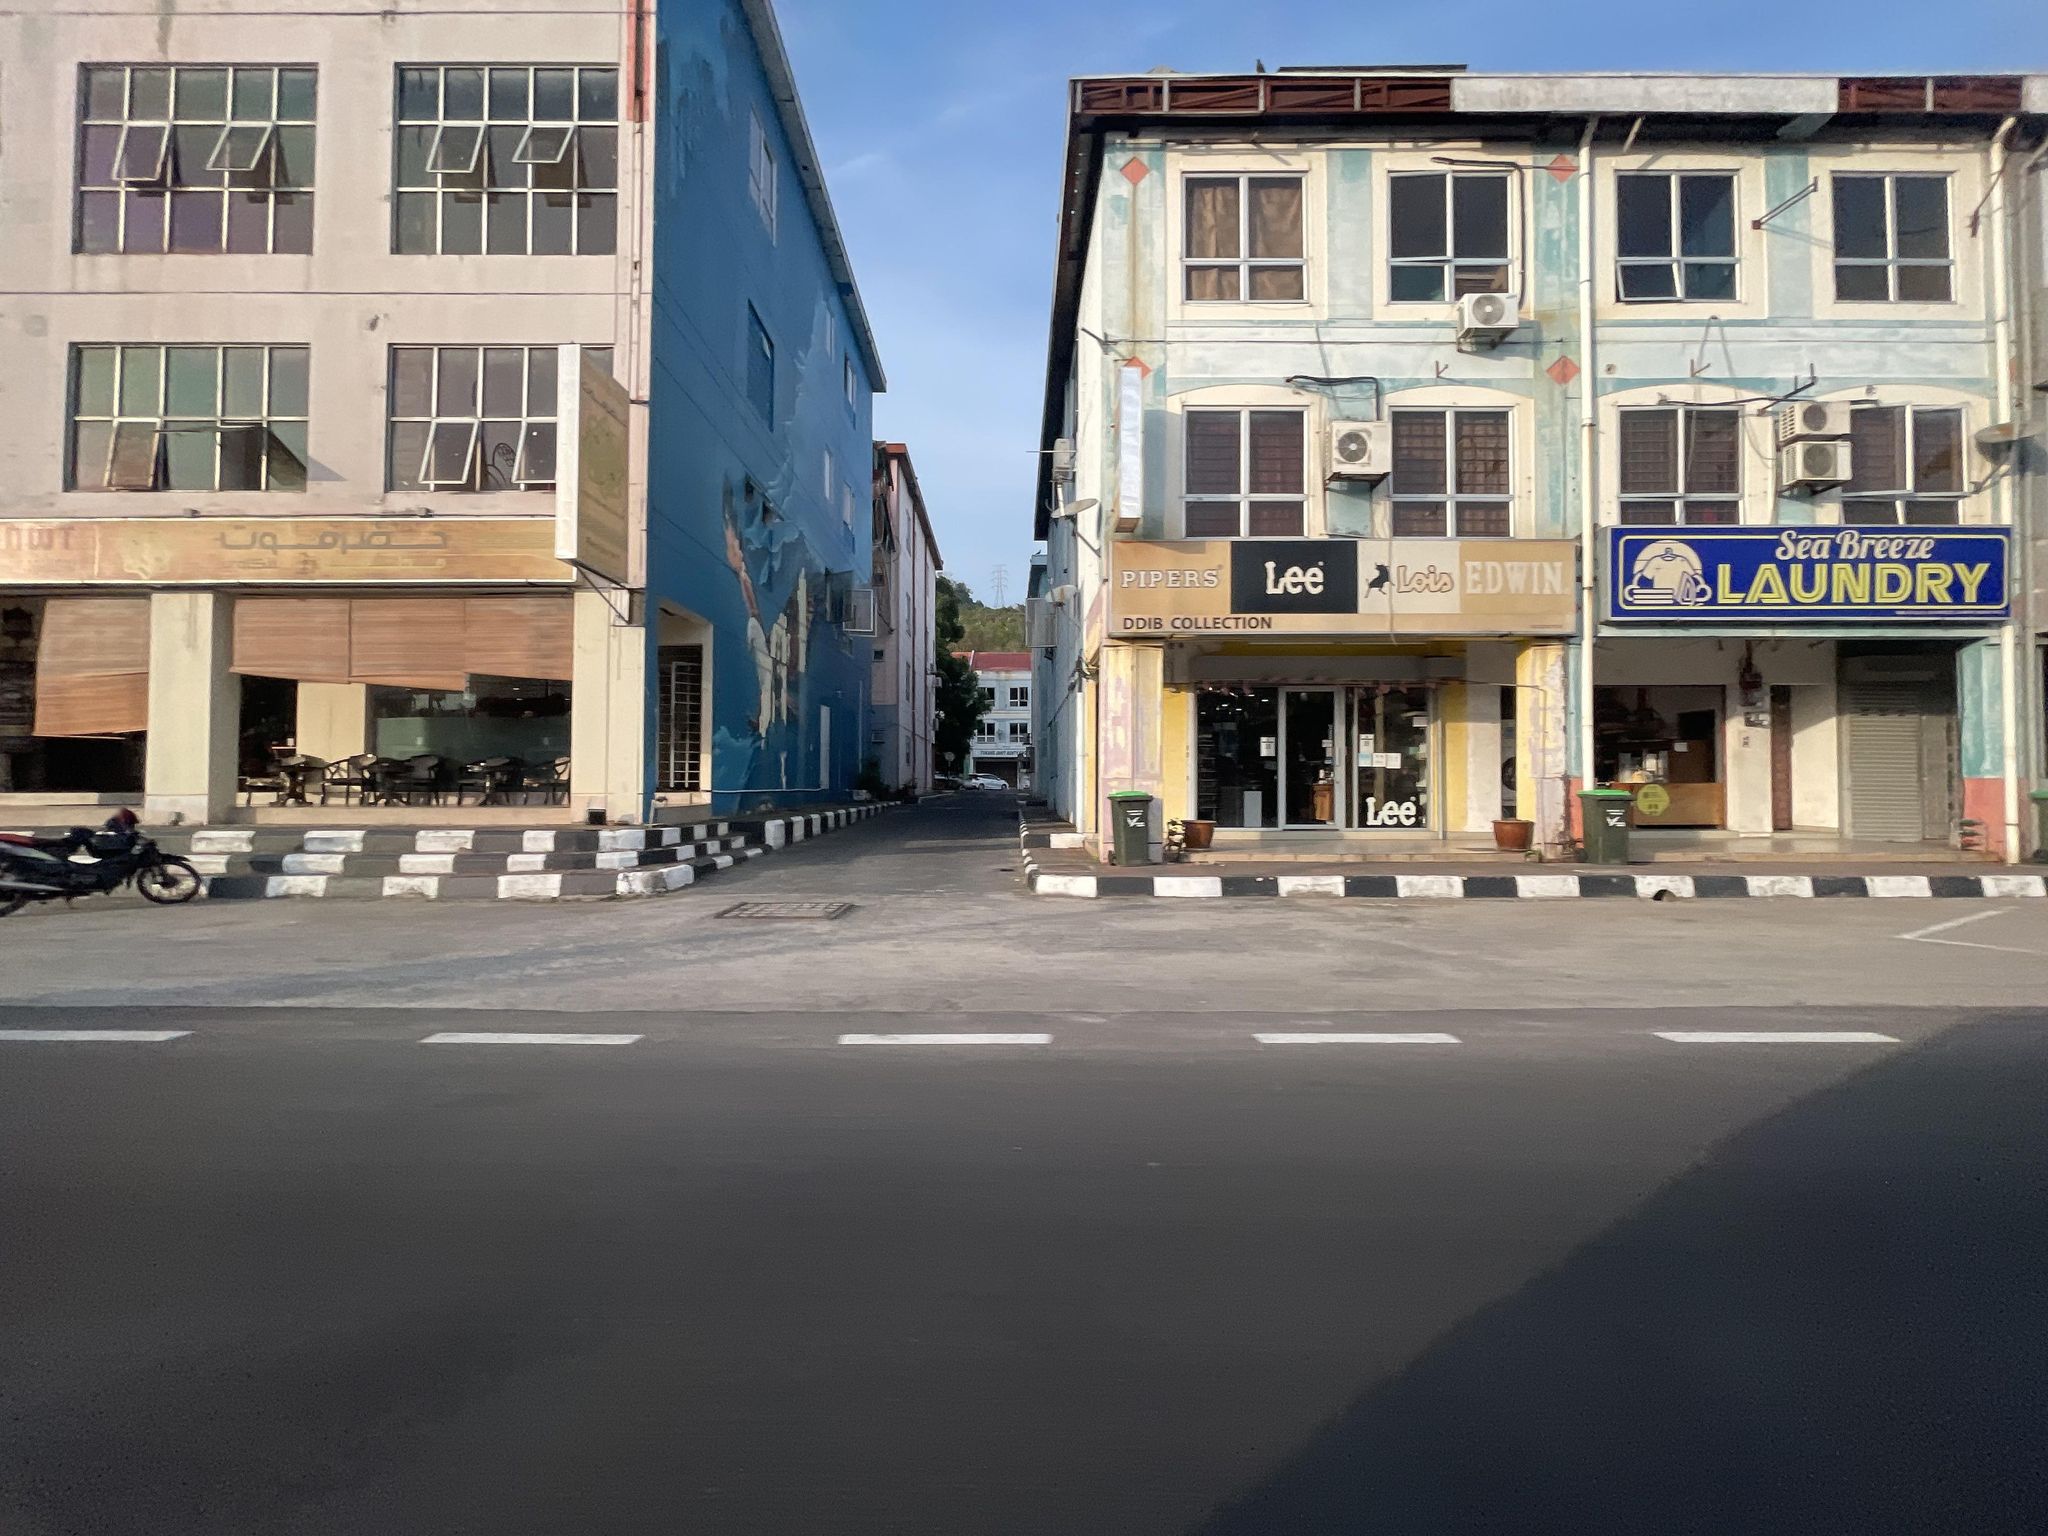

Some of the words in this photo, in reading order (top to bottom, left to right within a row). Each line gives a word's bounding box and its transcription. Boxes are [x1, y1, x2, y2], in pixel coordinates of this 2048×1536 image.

[1775, 530, 1831, 561] Sea
[1835, 530, 1936, 561] Breeze
[1120, 568, 1220, 588] PIPERS
[1264, 560, 1324, 595] Lee
[1395, 564, 1455, 594] Lois
[1464, 560, 1564, 595] EDWIN
[1717, 563, 1991, 604] LAUNDRY
[1123, 617, 1163, 630] DDIB
[1170, 616, 1273, 630] COLLECTION
[1365, 796, 1417, 826] Lee
